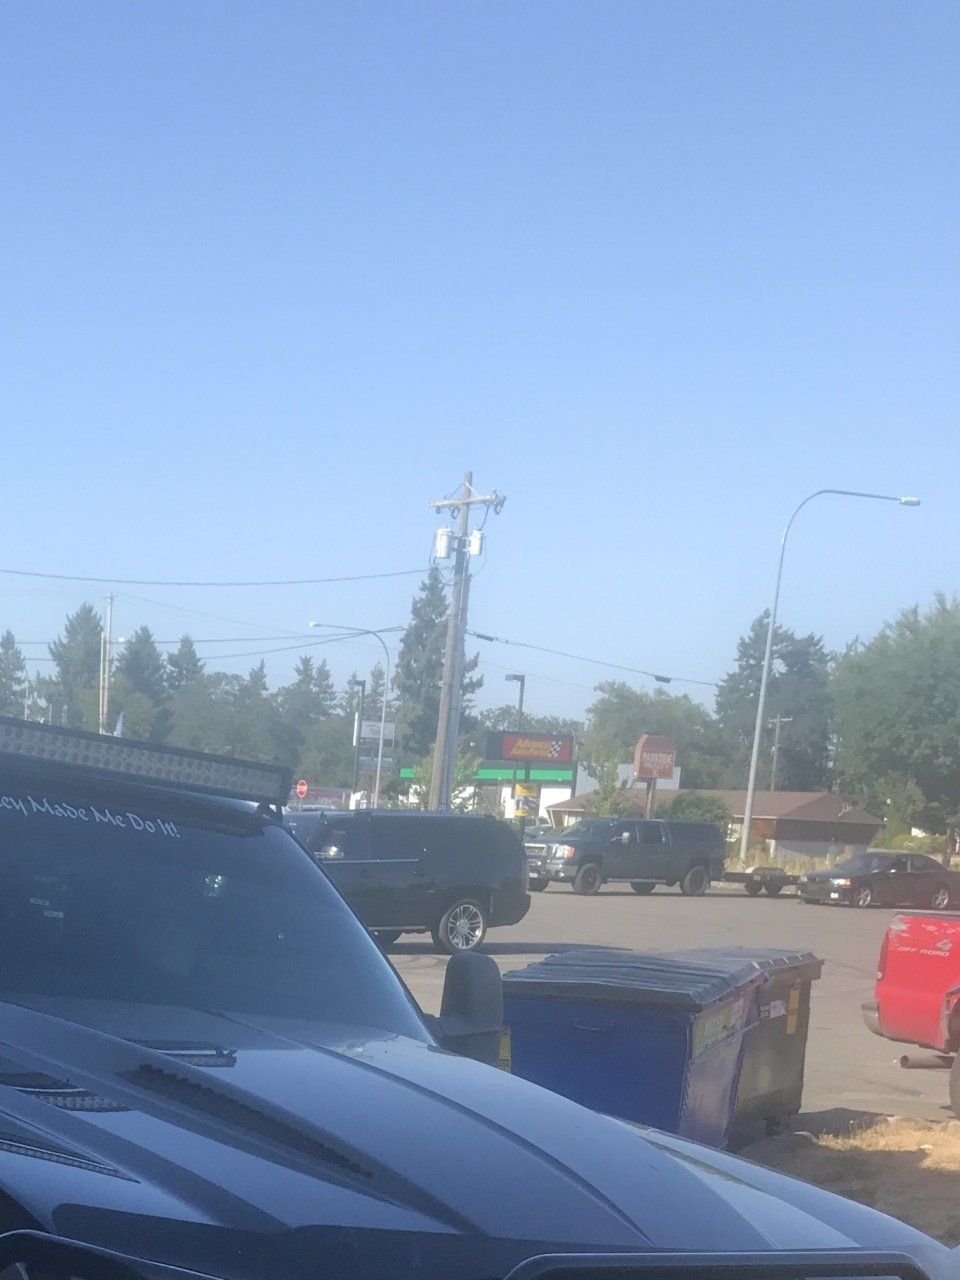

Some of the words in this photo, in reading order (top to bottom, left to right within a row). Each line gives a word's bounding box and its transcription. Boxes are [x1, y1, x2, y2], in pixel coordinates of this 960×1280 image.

[28, 796, 89, 822] Made
[89, 806, 127, 828] Me
[126, 812, 156, 834] Do
[157, 818, 182, 839] It!
